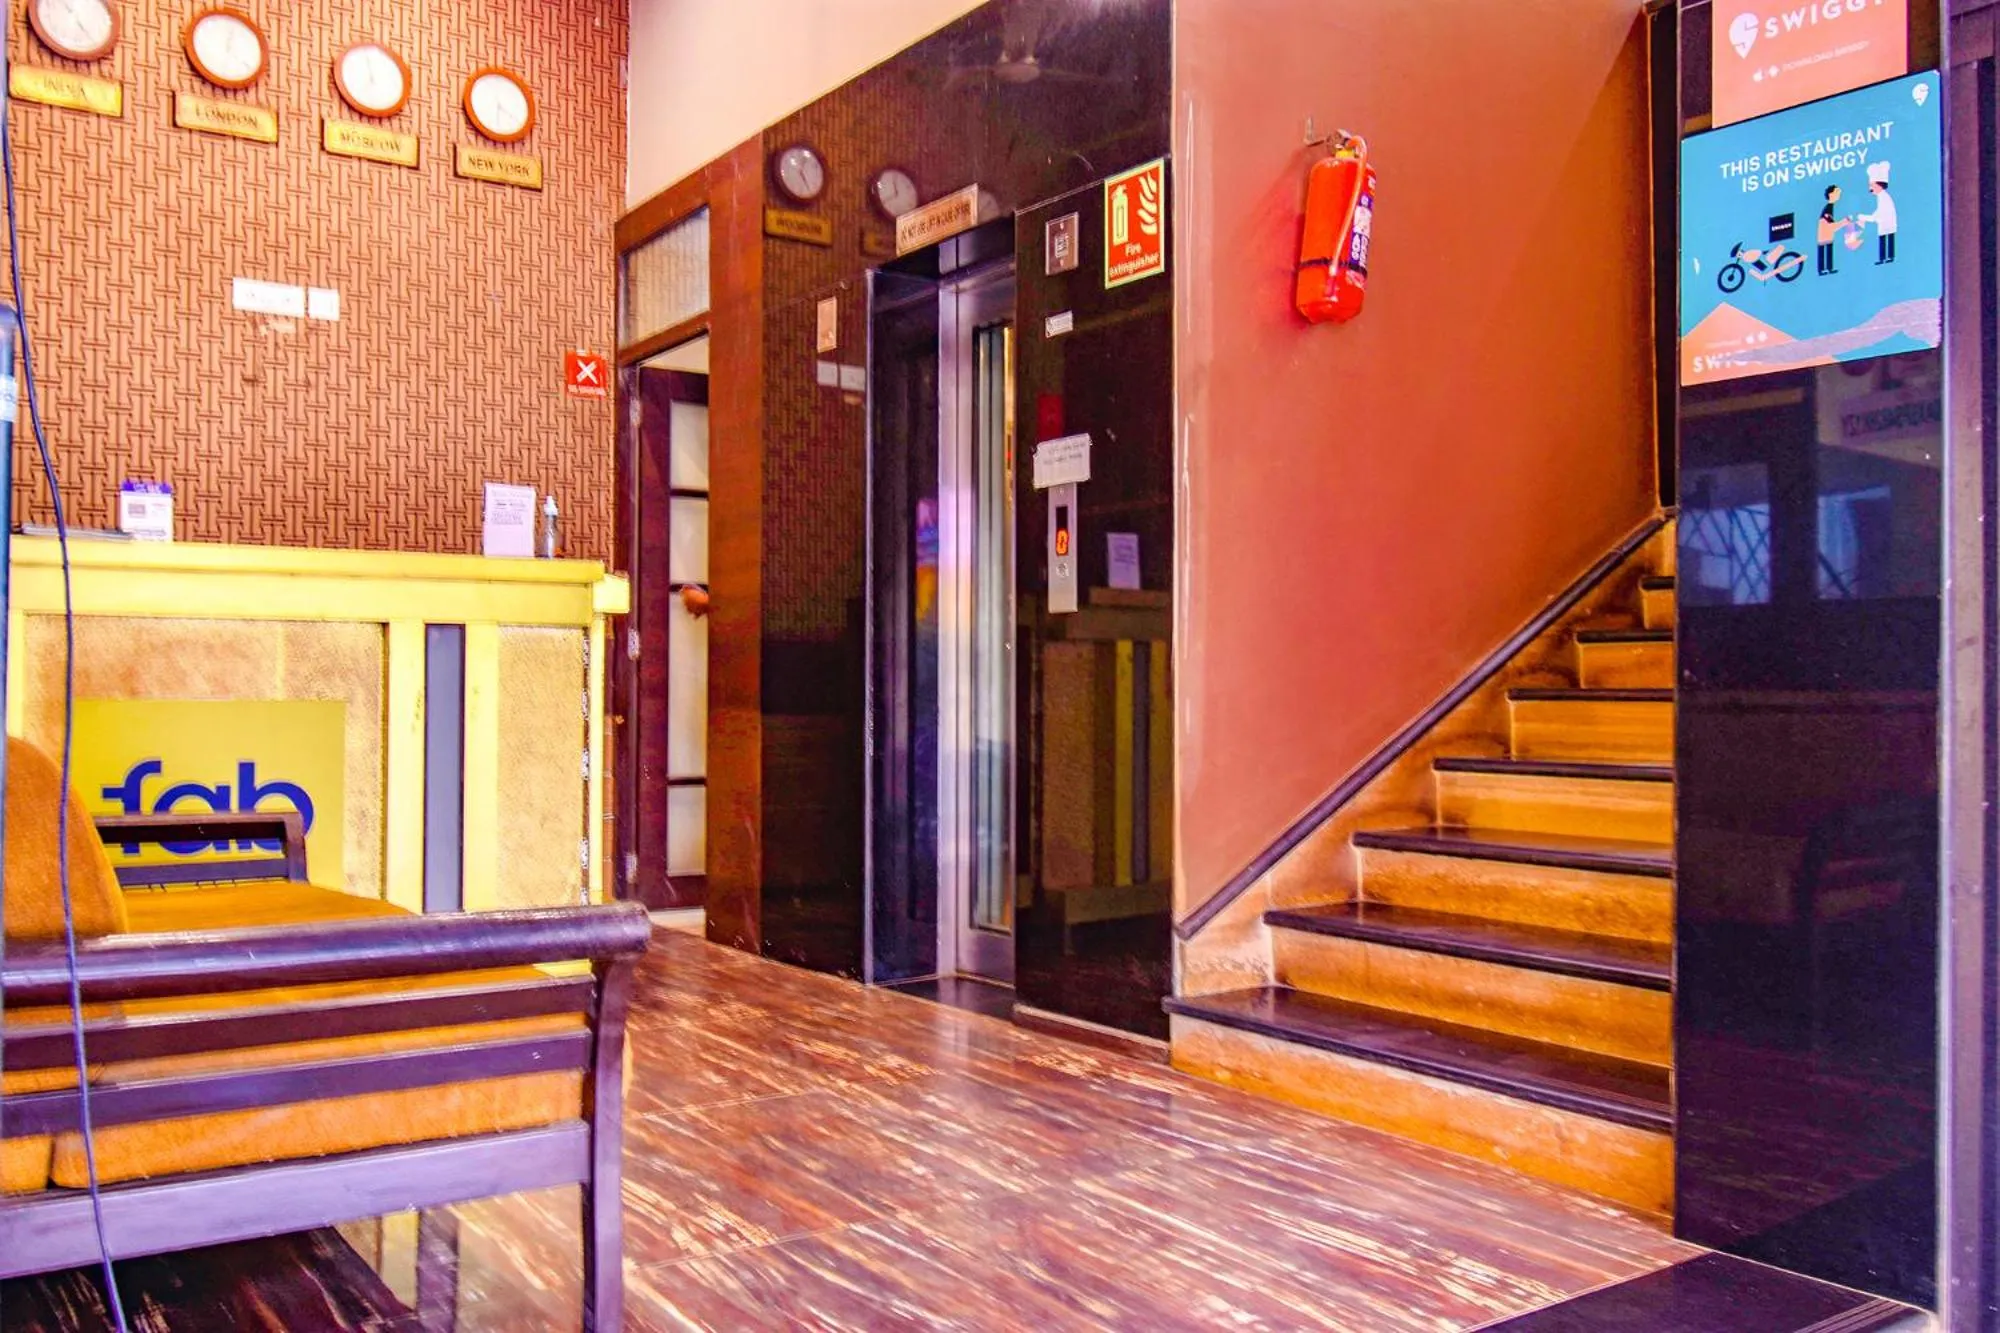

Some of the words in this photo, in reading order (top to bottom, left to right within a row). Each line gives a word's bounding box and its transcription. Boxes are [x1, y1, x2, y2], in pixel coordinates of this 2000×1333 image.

[1764, 0, 1884, 38] SWIGG
[195, 103, 259, 129] LONDON
[468, 155, 495, 172] NEW
[497, 159, 530, 177] YORK
[1720, 156, 1760, 179] THIS
[1765, 121, 1894, 168] RESTAURANT
[1742, 174, 1760, 192] IS
[1763, 168, 1789, 188] ON
[1794, 148, 1868, 180] SWIGGY
[1125, 241, 1142, 257] Fire
[102, 760, 314, 855] fab
